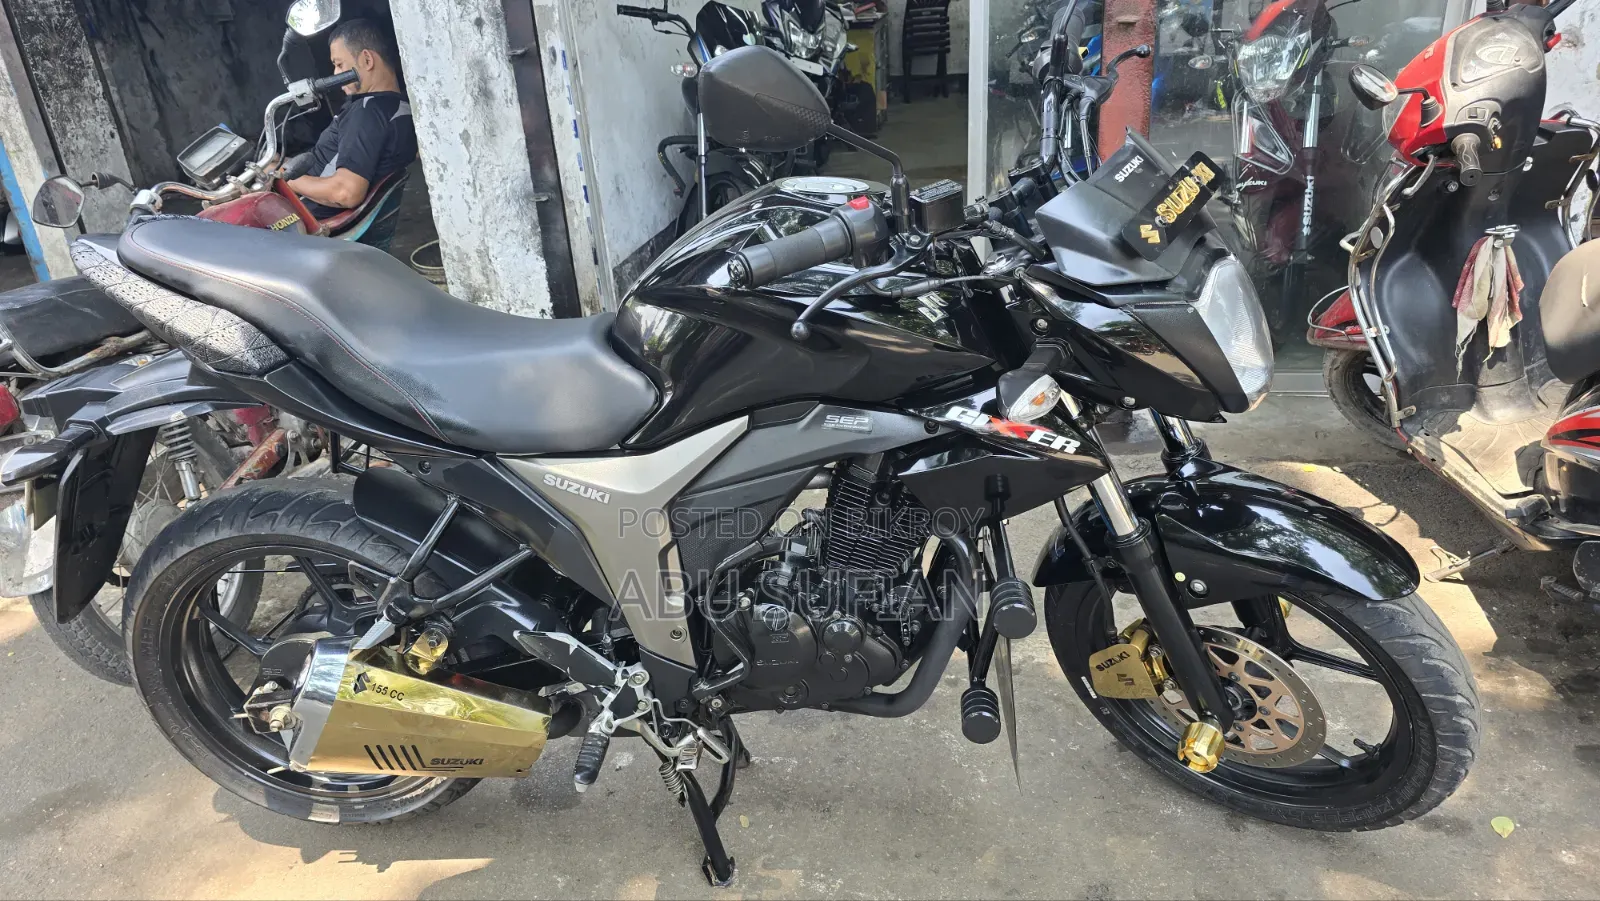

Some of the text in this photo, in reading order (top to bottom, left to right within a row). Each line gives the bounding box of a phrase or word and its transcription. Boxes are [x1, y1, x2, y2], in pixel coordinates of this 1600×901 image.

[1114, 155, 1144, 182] SUZUKI
[1156, 161, 1215, 224] SUZUKI
[1303, 174, 1314, 226] SUZUKI
[270, 213, 300, 231] HONDA
[824, 414, 870, 425] SEP
[543, 473, 611, 504] SUZUKI
[1095, 651, 1131, 671] SUZUKI
[371, 683, 405, 702] 155 CC
[430, 758, 484, 766] SUZUKI
